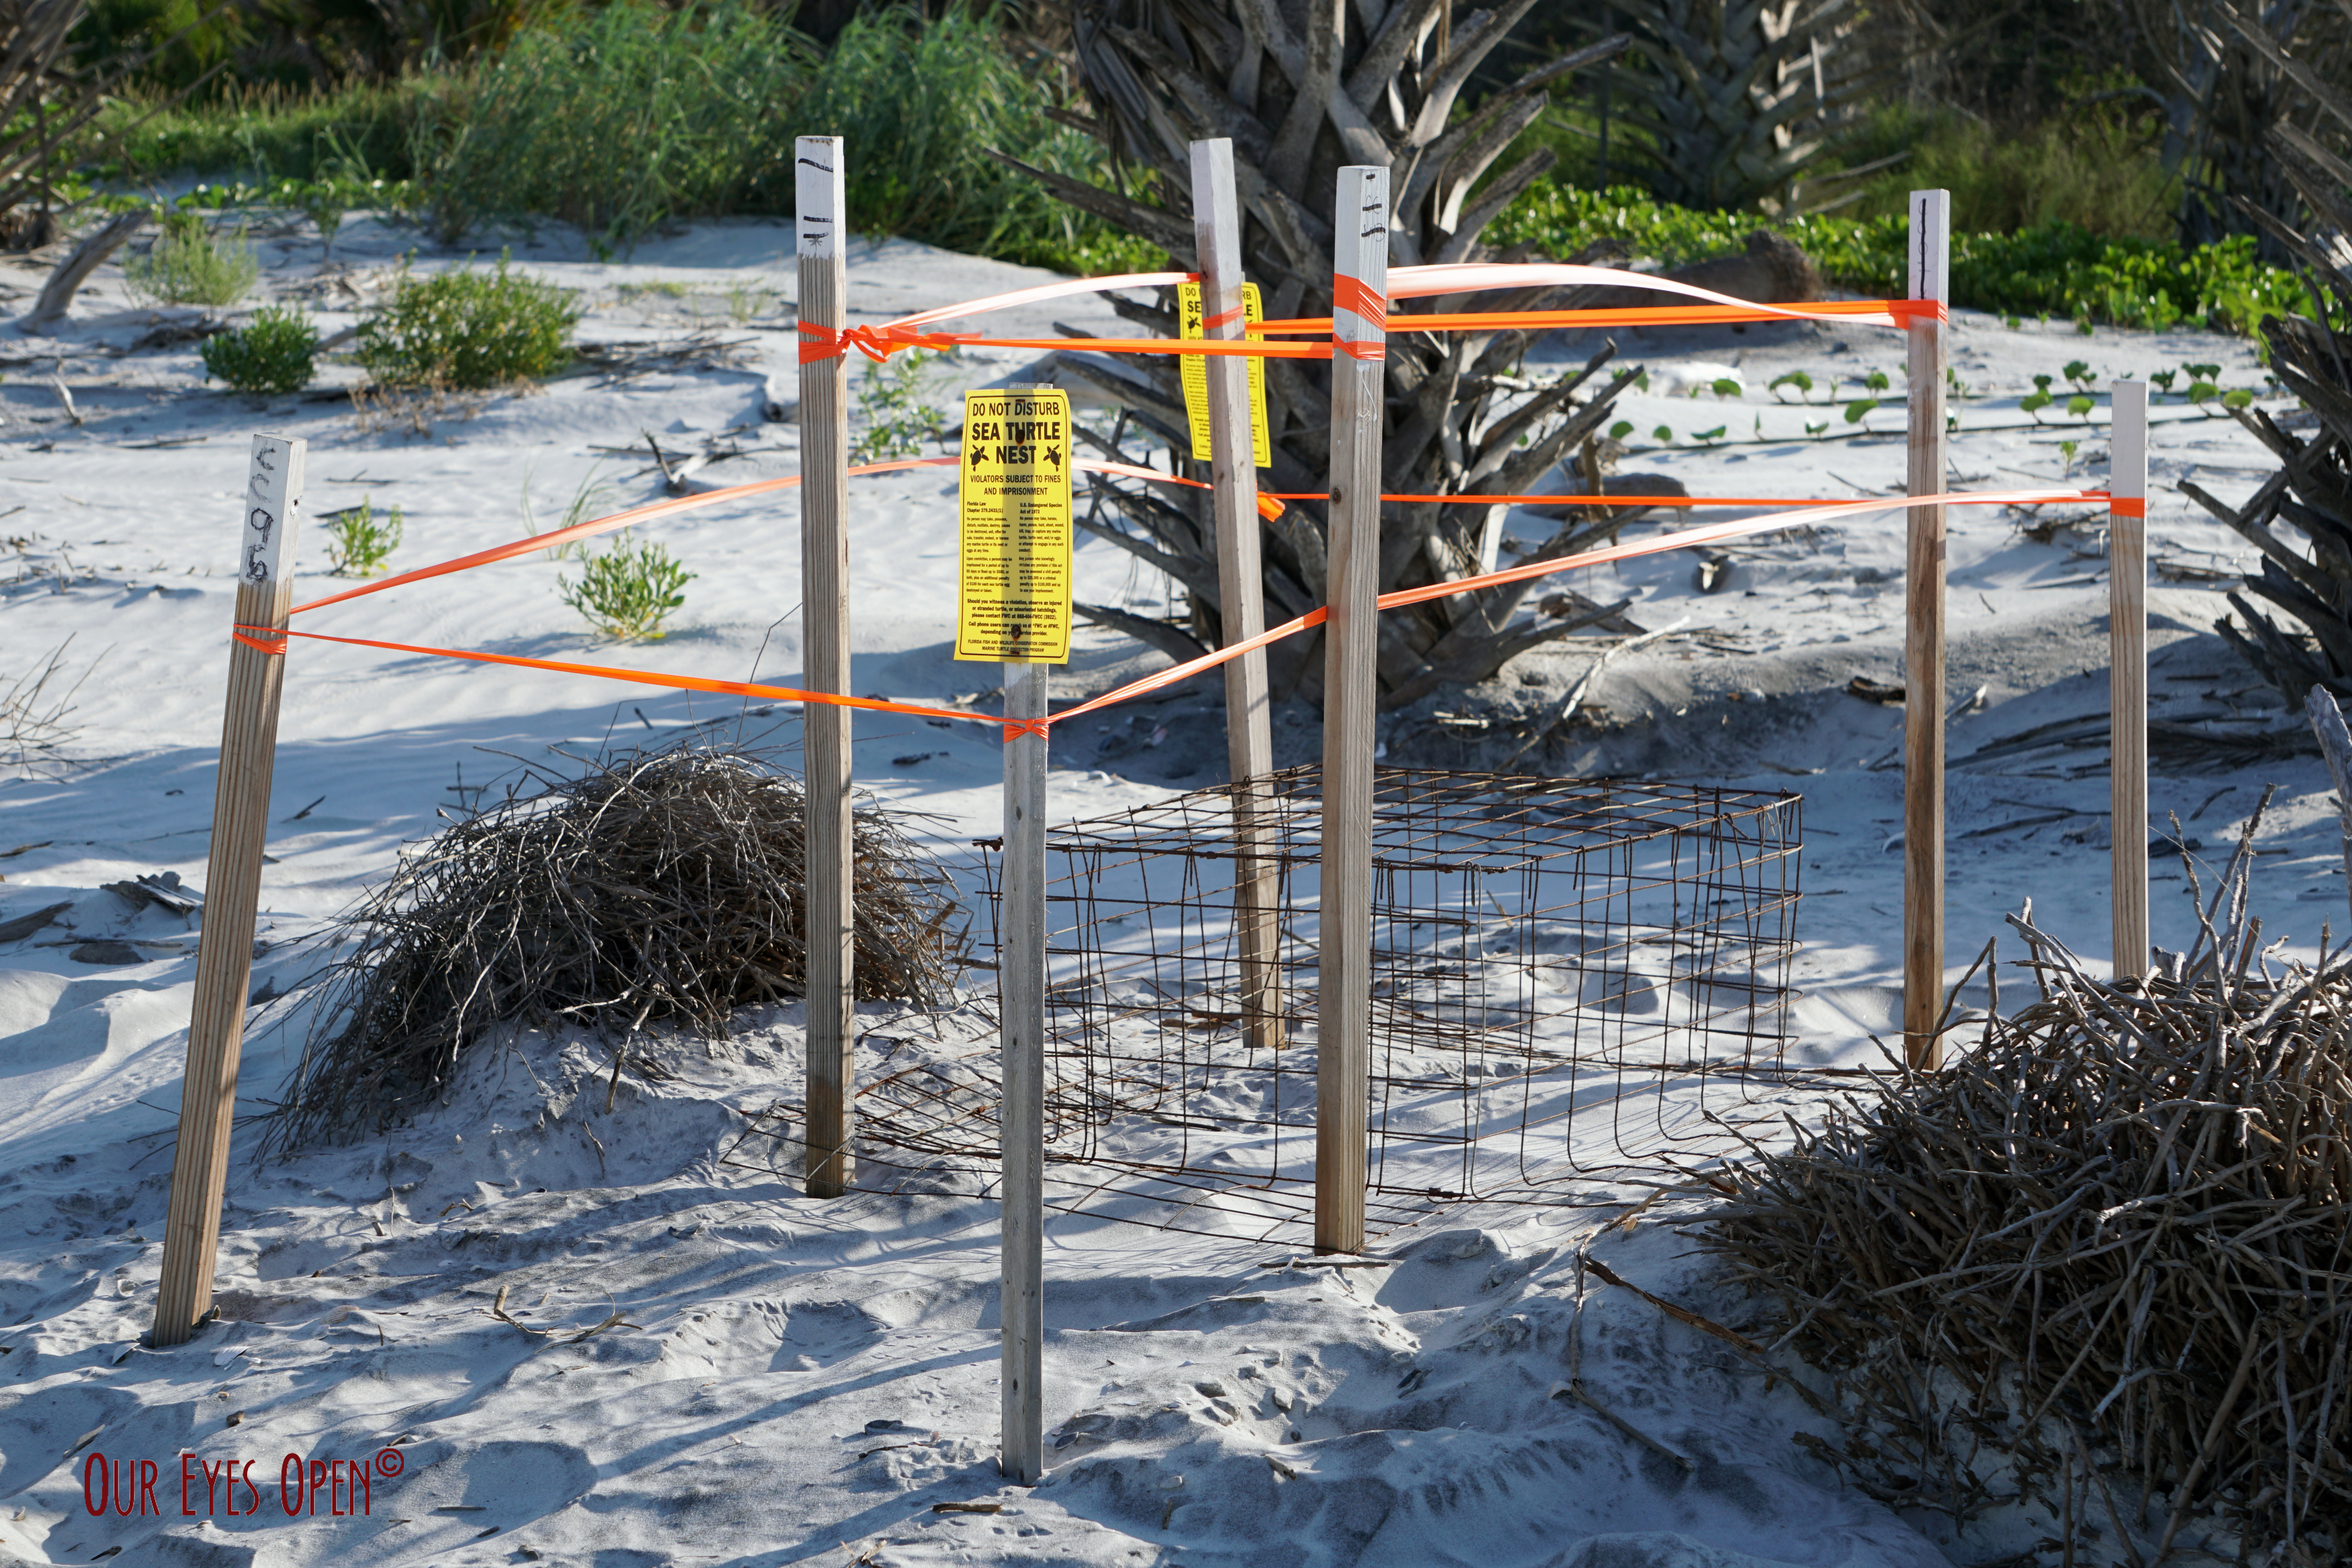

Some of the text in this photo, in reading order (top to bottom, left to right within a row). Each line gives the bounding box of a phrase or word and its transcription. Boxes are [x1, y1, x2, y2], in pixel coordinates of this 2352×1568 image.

[1185, 287, 1196, 296] DO
[1187, 301, 1201, 313] SE
[973, 402, 1060, 416] DO NOT DISTURB
[972, 422, 1060, 441] SEA TURTLE
[996, 445, 1036, 464] NEST
